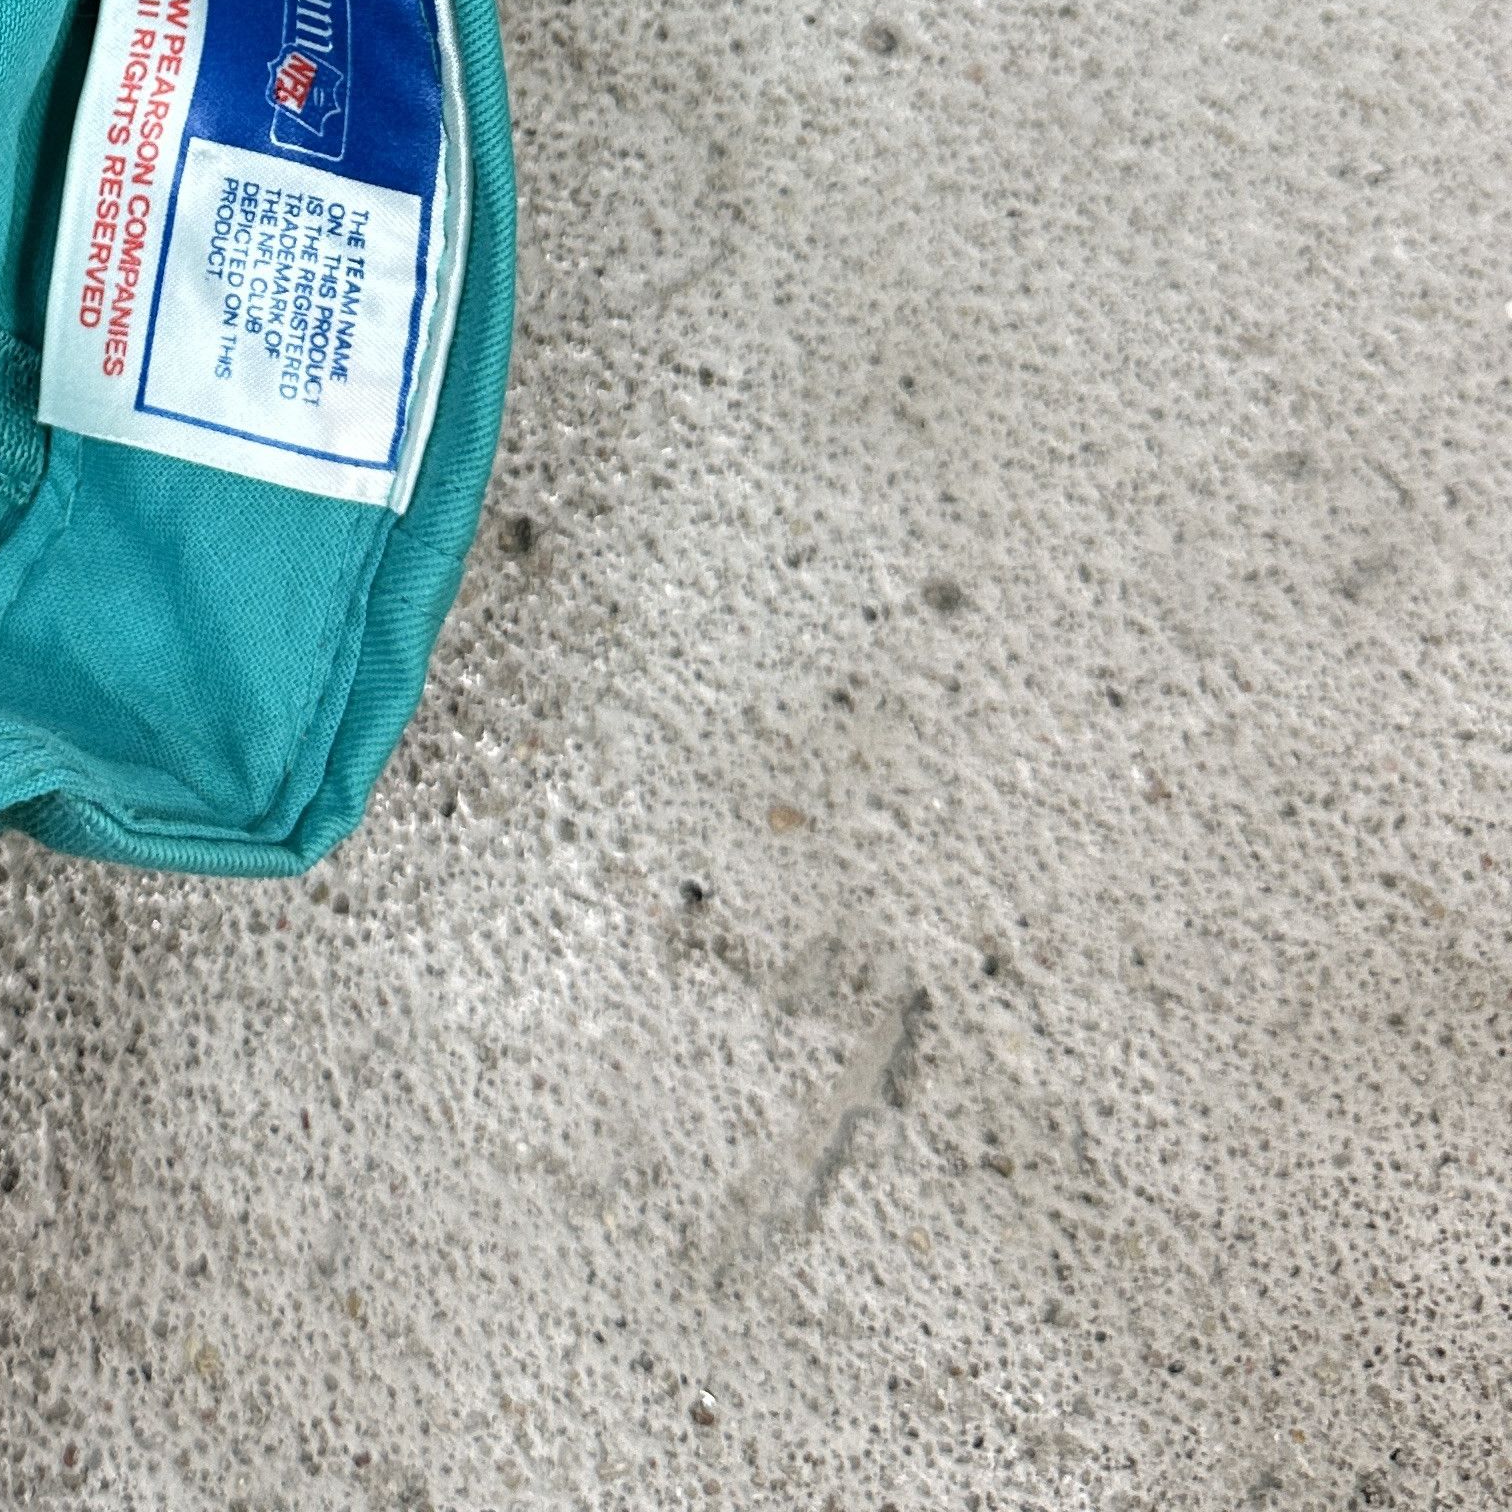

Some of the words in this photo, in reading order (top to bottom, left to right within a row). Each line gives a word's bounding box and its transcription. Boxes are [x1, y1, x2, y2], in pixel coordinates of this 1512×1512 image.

[107, 28, 156, 145] RIGHTS
[131, 34, 186, 186] PEARSON
[274, 52, 317, 112] NFL
[227, 181, 260, 288] DEPICTED
[260, 188, 282, 227] THE
[305, 194, 324, 217] IS
[347, 210, 369, 249] THE
[79, 154, 126, 328] RESERVED
[253, 232, 275, 269] NFL
[268, 189, 303, 325] TRADEMARK
[301, 225, 322, 264] THE
[102, 194, 150, 376] COMPANIES
[245, 277, 268, 334] CLUB
[319, 254, 341, 298] THIS
[340, 257, 365, 316] TEAM
[222, 293, 242, 327] ON
[279, 267, 316, 399] REGISTERED
[214, 335, 237, 380] THIS
[264, 330, 282, 359] OF
[303, 305, 333, 406] PRODUCT
[329, 320, 356, 383] NAME
